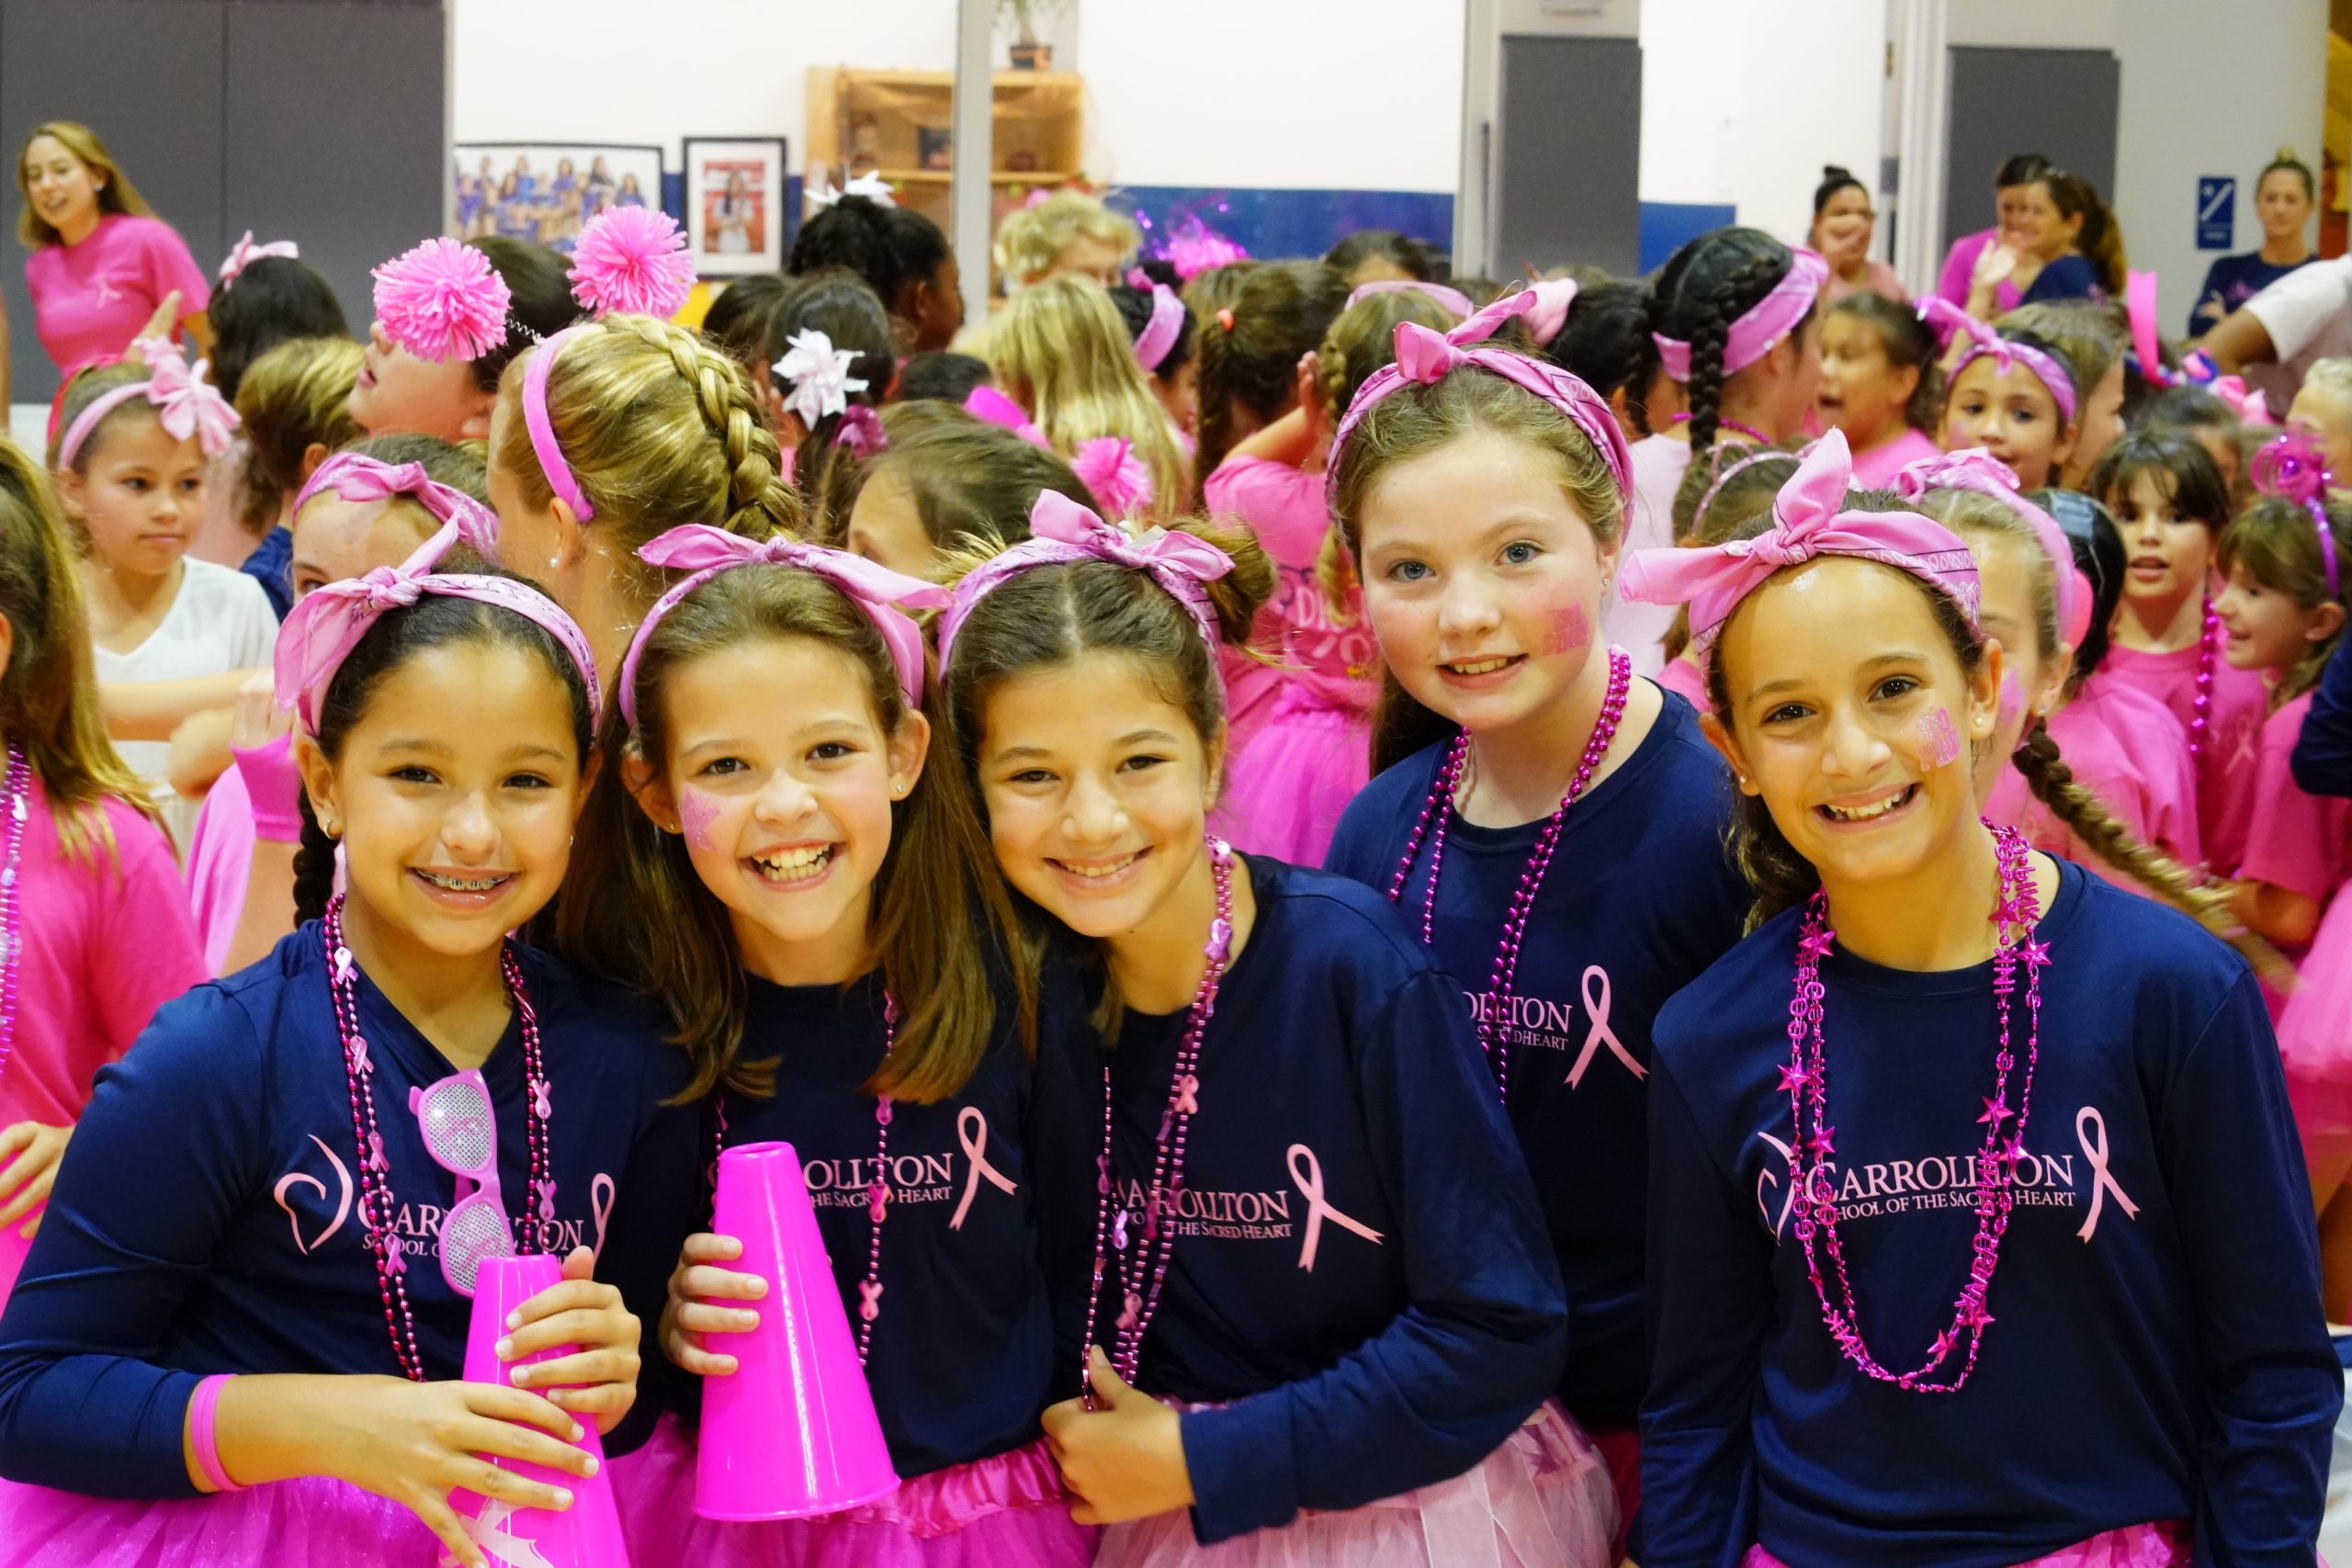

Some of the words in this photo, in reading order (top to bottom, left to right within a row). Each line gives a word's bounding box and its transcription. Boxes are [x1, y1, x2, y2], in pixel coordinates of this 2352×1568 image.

[1462, 991, 1573, 1033] OLLTON
[1522, 1030, 1569, 1051] HEART
[802, 1152, 954, 1190] OLLTON
[1804, 1155, 2075, 1206] CARROLLON
[897, 1186, 953, 1204] HEART
[1885, 1196, 1910, 1213] OF
[1912, 1192, 1949, 1210] THE
[2014, 1189, 2076, 1207] HEART
[1241, 1223, 1293, 1239] HEART
